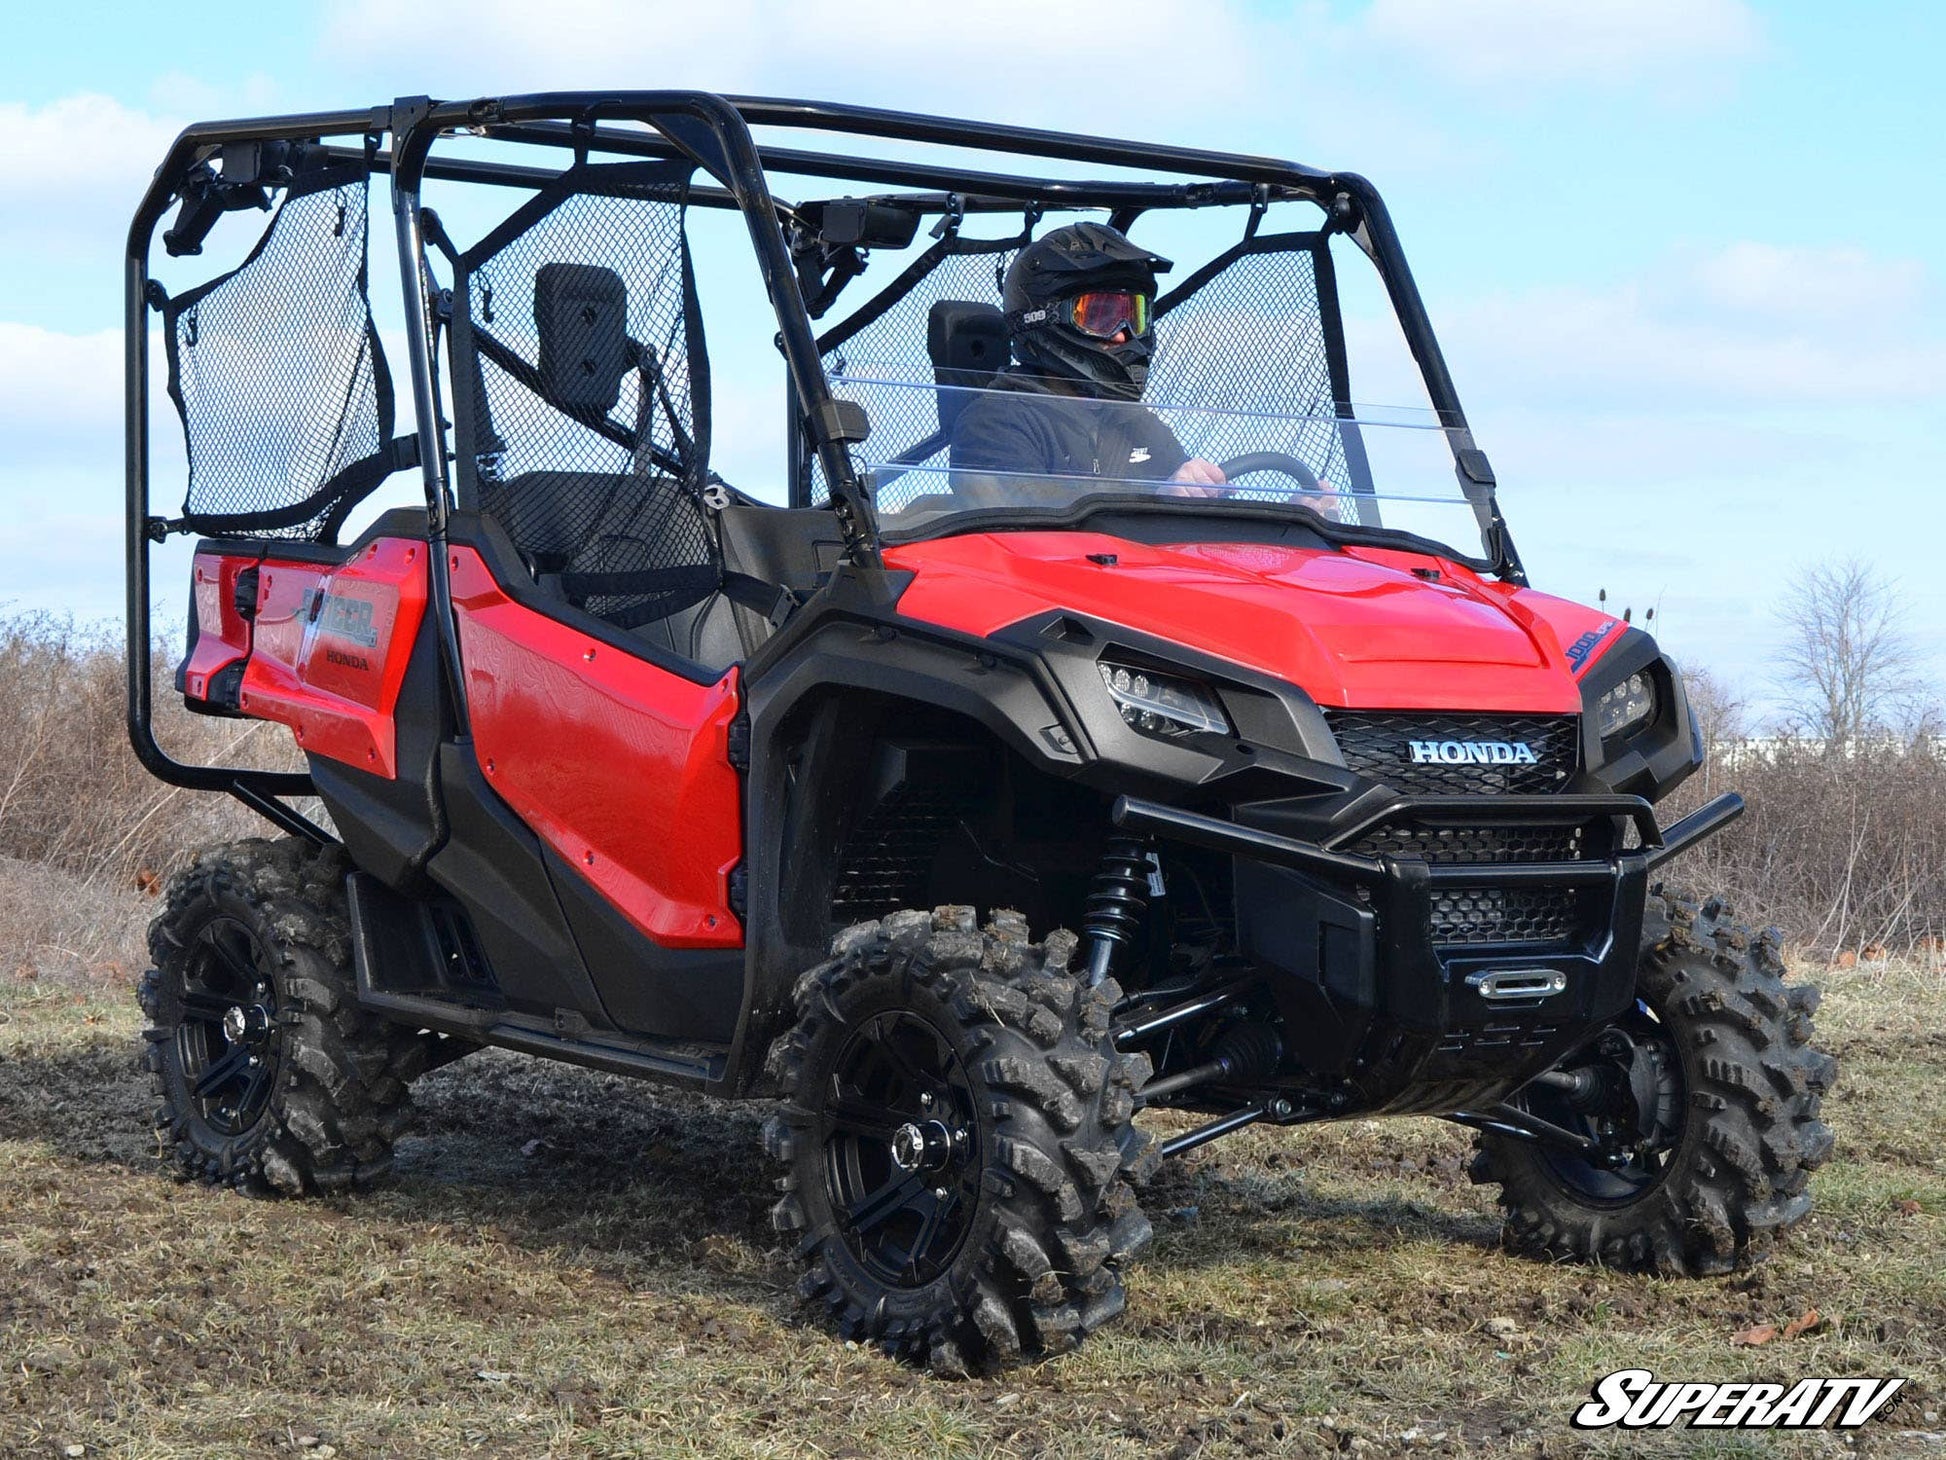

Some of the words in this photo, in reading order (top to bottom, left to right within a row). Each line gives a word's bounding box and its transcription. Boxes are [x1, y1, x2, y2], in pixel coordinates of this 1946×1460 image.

[1023, 309, 1046, 324] 509
[1565, 632, 1600, 660] 1000
[327, 650, 369, 671] HONDA
[1409, 741, 1538, 764] HONDA
